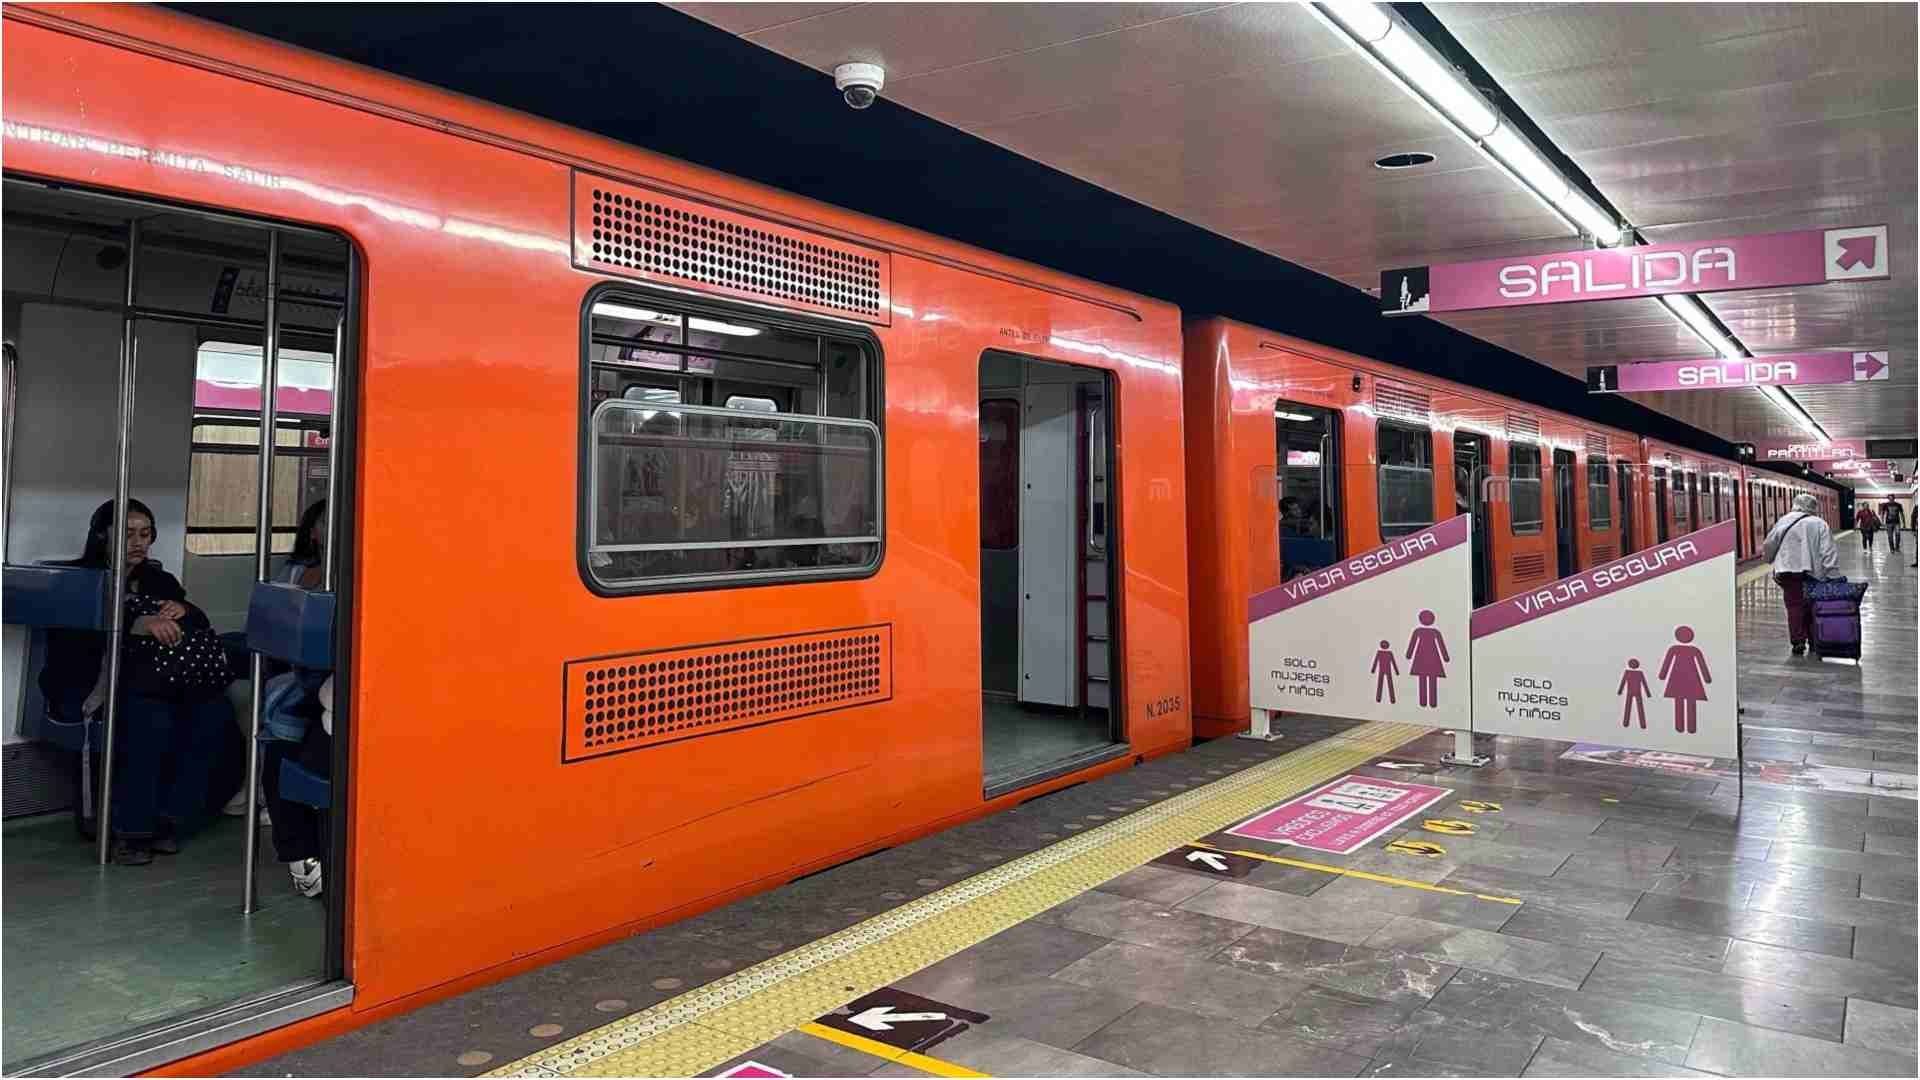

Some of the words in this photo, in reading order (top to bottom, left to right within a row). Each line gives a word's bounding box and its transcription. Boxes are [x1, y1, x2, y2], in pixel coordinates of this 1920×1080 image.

[1499, 247, 1737, 298] SALIDA
[1677, 361, 1797, 385] SALIDA
[1284, 567, 1346, 600] VIAJA
[1350, 532, 1438, 576] SEGURA
[1515, 579, 1588, 614] VIAJA
[1593, 540, 1698, 588] SEGURA
[1283, 657, 1317, 669] SOLO
[1271, 670, 1330, 683] MUJERES
[1513, 678, 1552, 690] SOLO
[1277, 684, 1286, 694] Y
[1498, 691, 1568, 706] MUJERES
[1505, 706, 1515, 717] Y
[1519, 707, 1561, 721] NIÑOS
